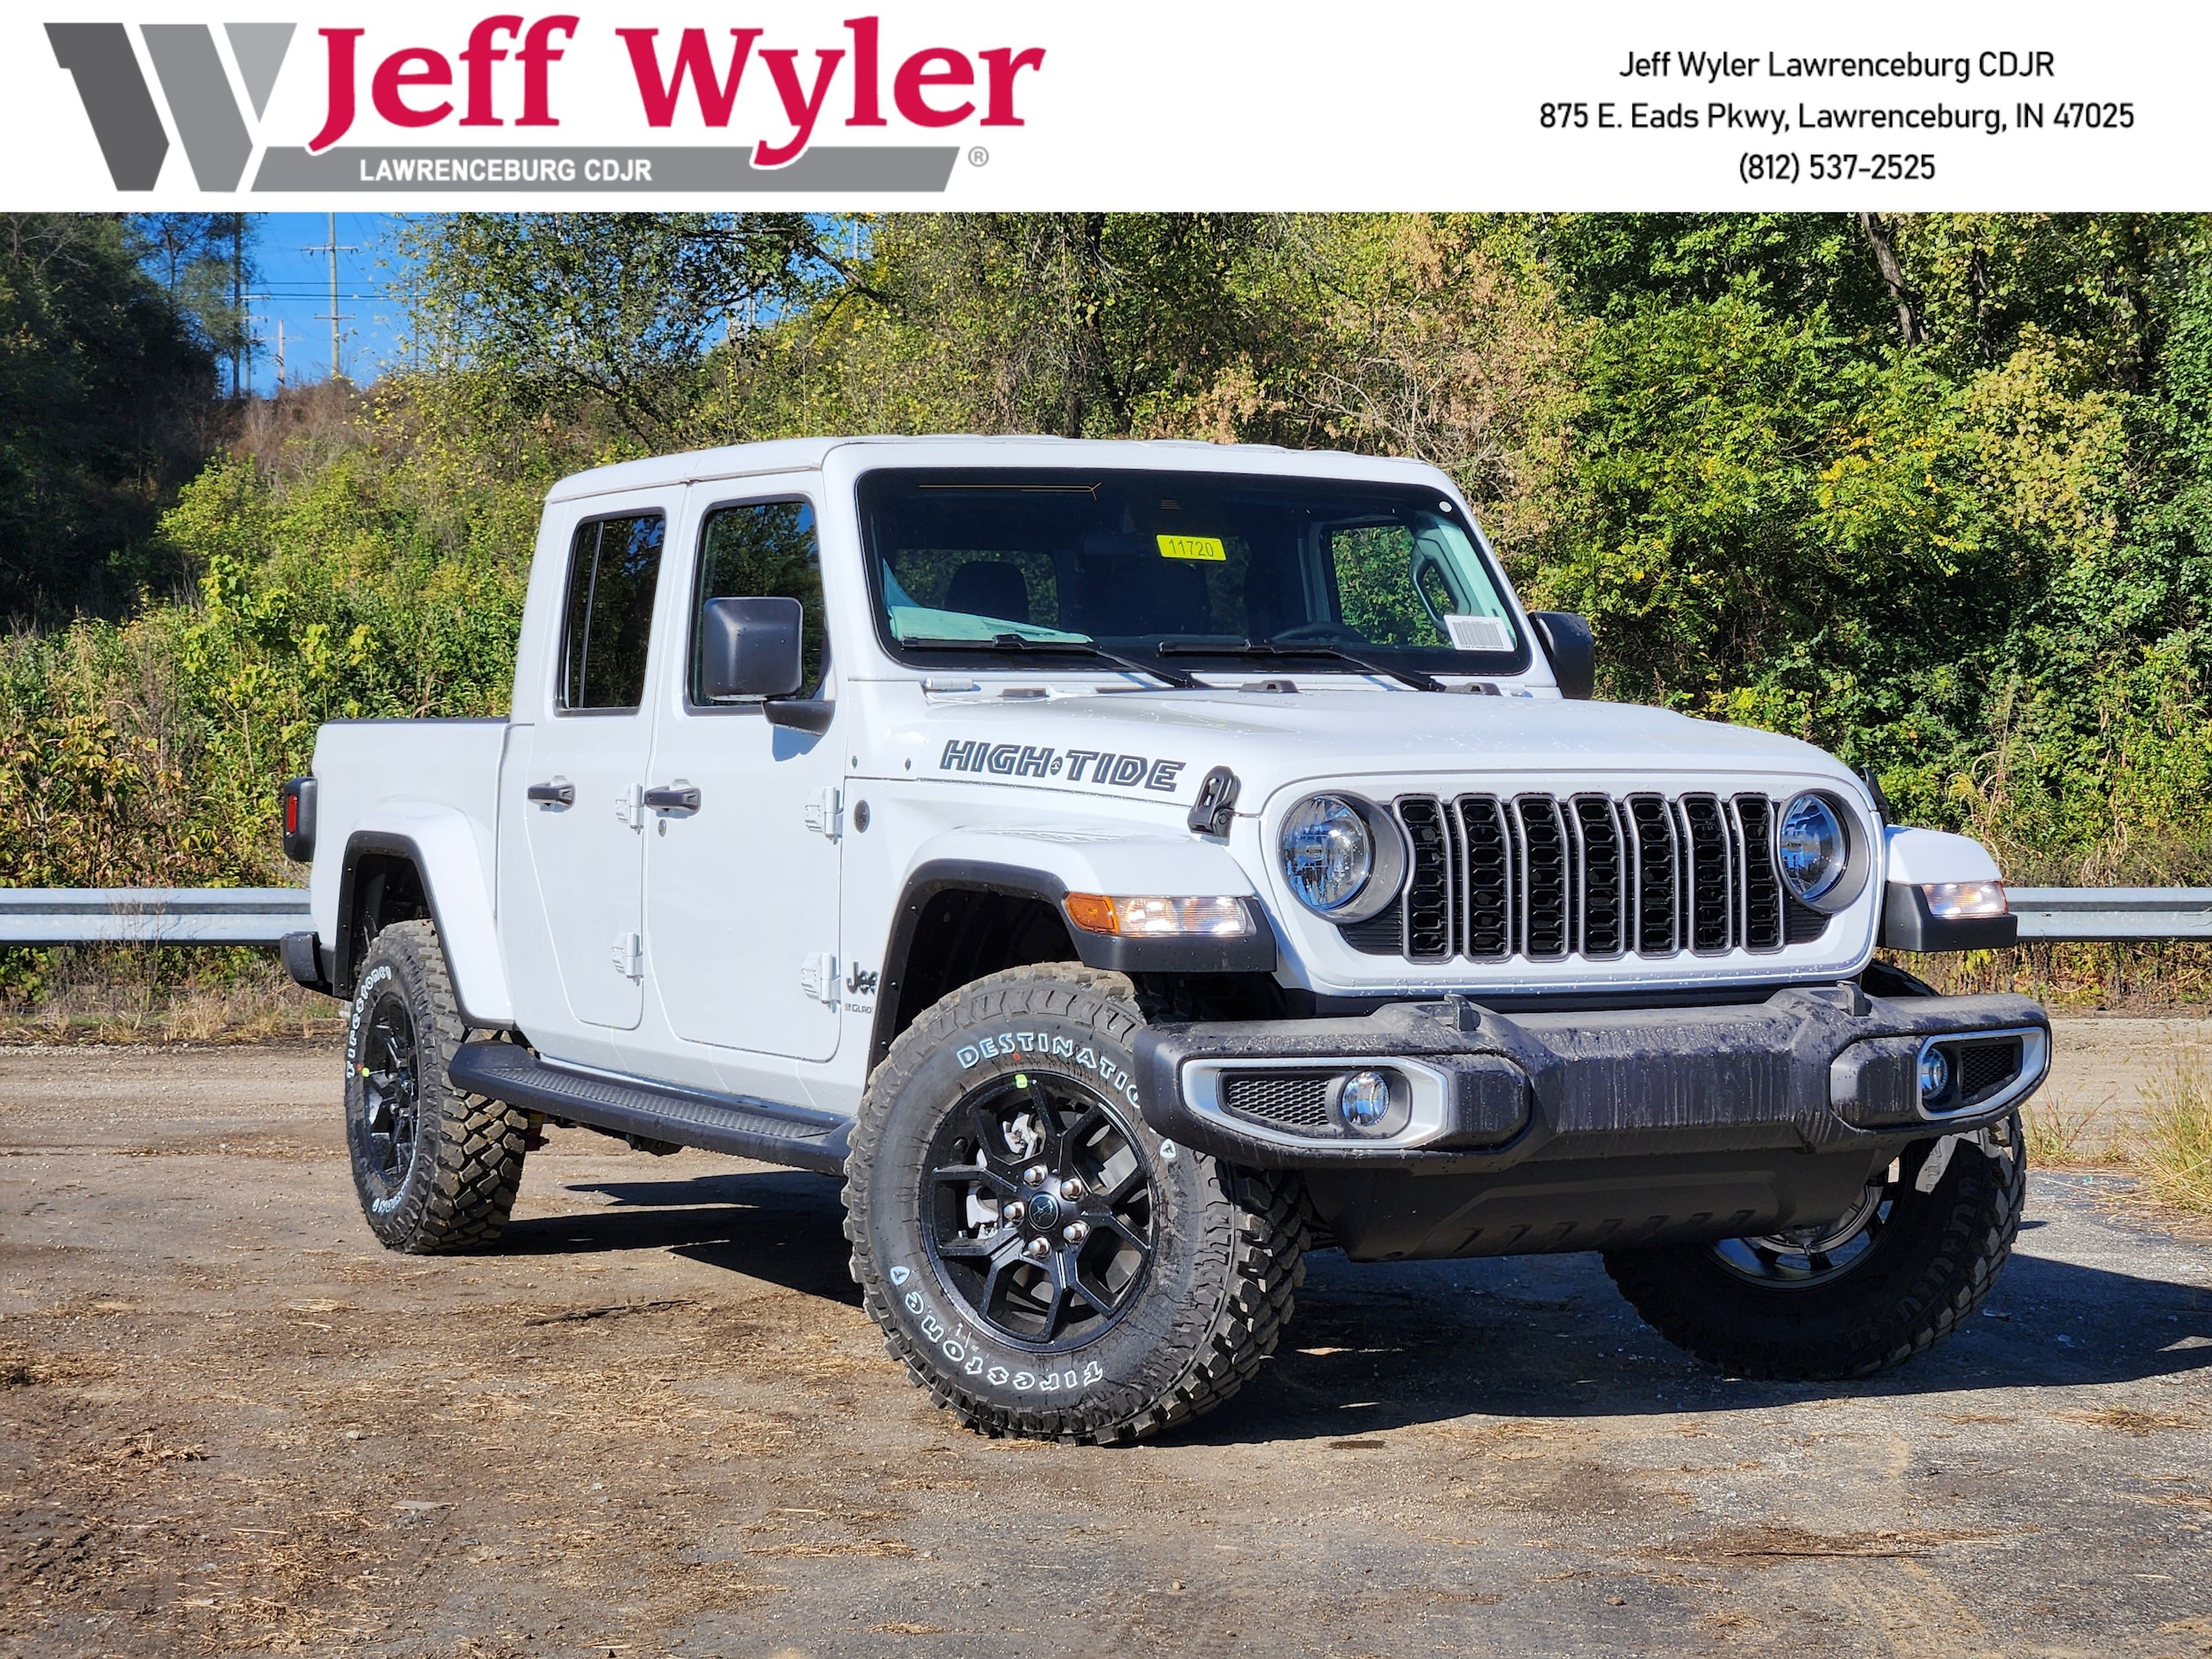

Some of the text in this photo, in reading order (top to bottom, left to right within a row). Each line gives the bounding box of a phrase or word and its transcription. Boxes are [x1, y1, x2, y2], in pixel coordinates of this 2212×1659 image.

[1168, 539, 1214, 557] 11720
[939, 740, 1187, 793] HIGH TIDE
[846, 962, 879, 995] Jee
[851, 1003, 873, 1014] GLAD
[956, 1033, 1141, 1110] DESTINATIO
